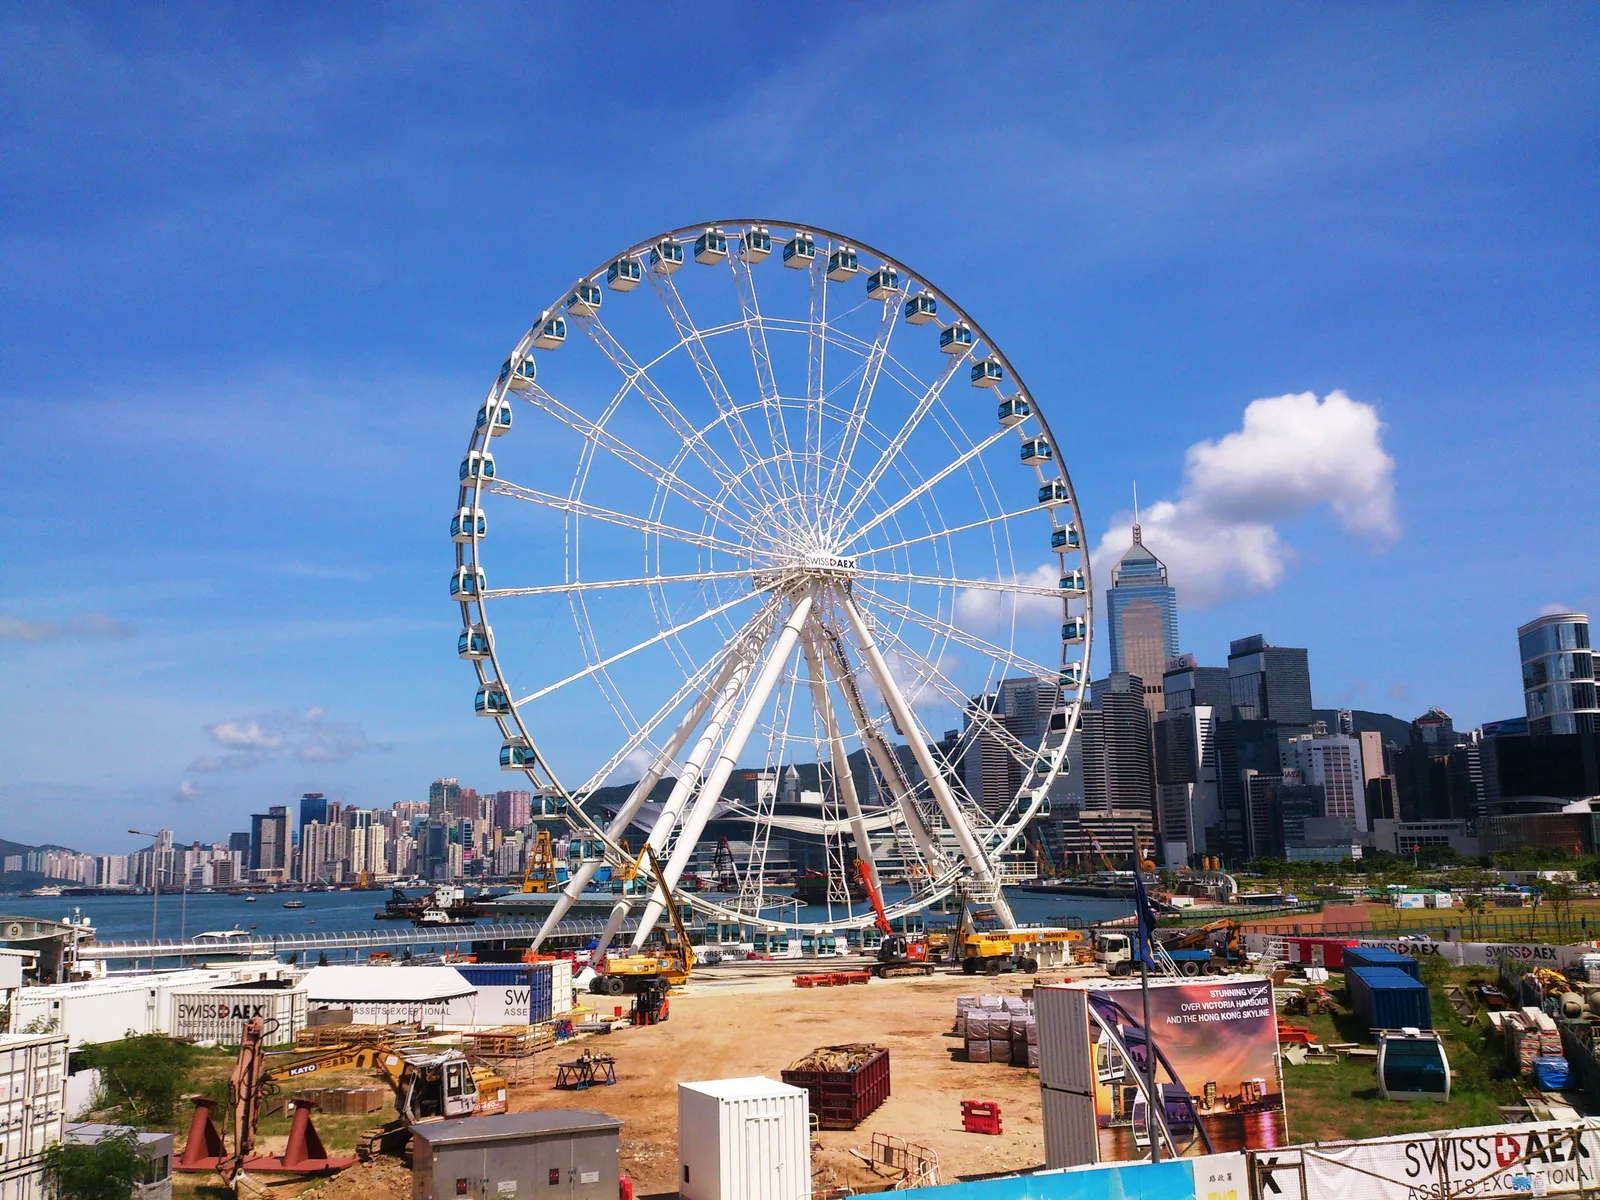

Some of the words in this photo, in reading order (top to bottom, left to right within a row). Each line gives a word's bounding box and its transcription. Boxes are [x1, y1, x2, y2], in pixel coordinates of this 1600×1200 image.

[11, 926, 18, 936] 9
[1209, 987, 1247, 998] STUNNING
[1247, 985, 1268, 996] VIEWS
[1180, 1002, 1201, 1012] OVER
[1201, 1000, 1235, 1011] VICTORIA
[1236, 997, 1269, 1008] HARBOUR
[353, 1007, 387, 1016] ASSETS
[1166, 1015, 1182, 1024] AND
[1182, 1014, 1198, 1023] THE
[1198, 1012, 1220, 1022] HONG
[1220, 1010, 1241, 1021] KONG
[1242, 1008, 1270, 1019] SKYLINE
[178, 1020, 207, 1028] ASSETS
[290, 1064, 316, 1076] KATO
[1209, 1172, 1232, 1183] 路政署
